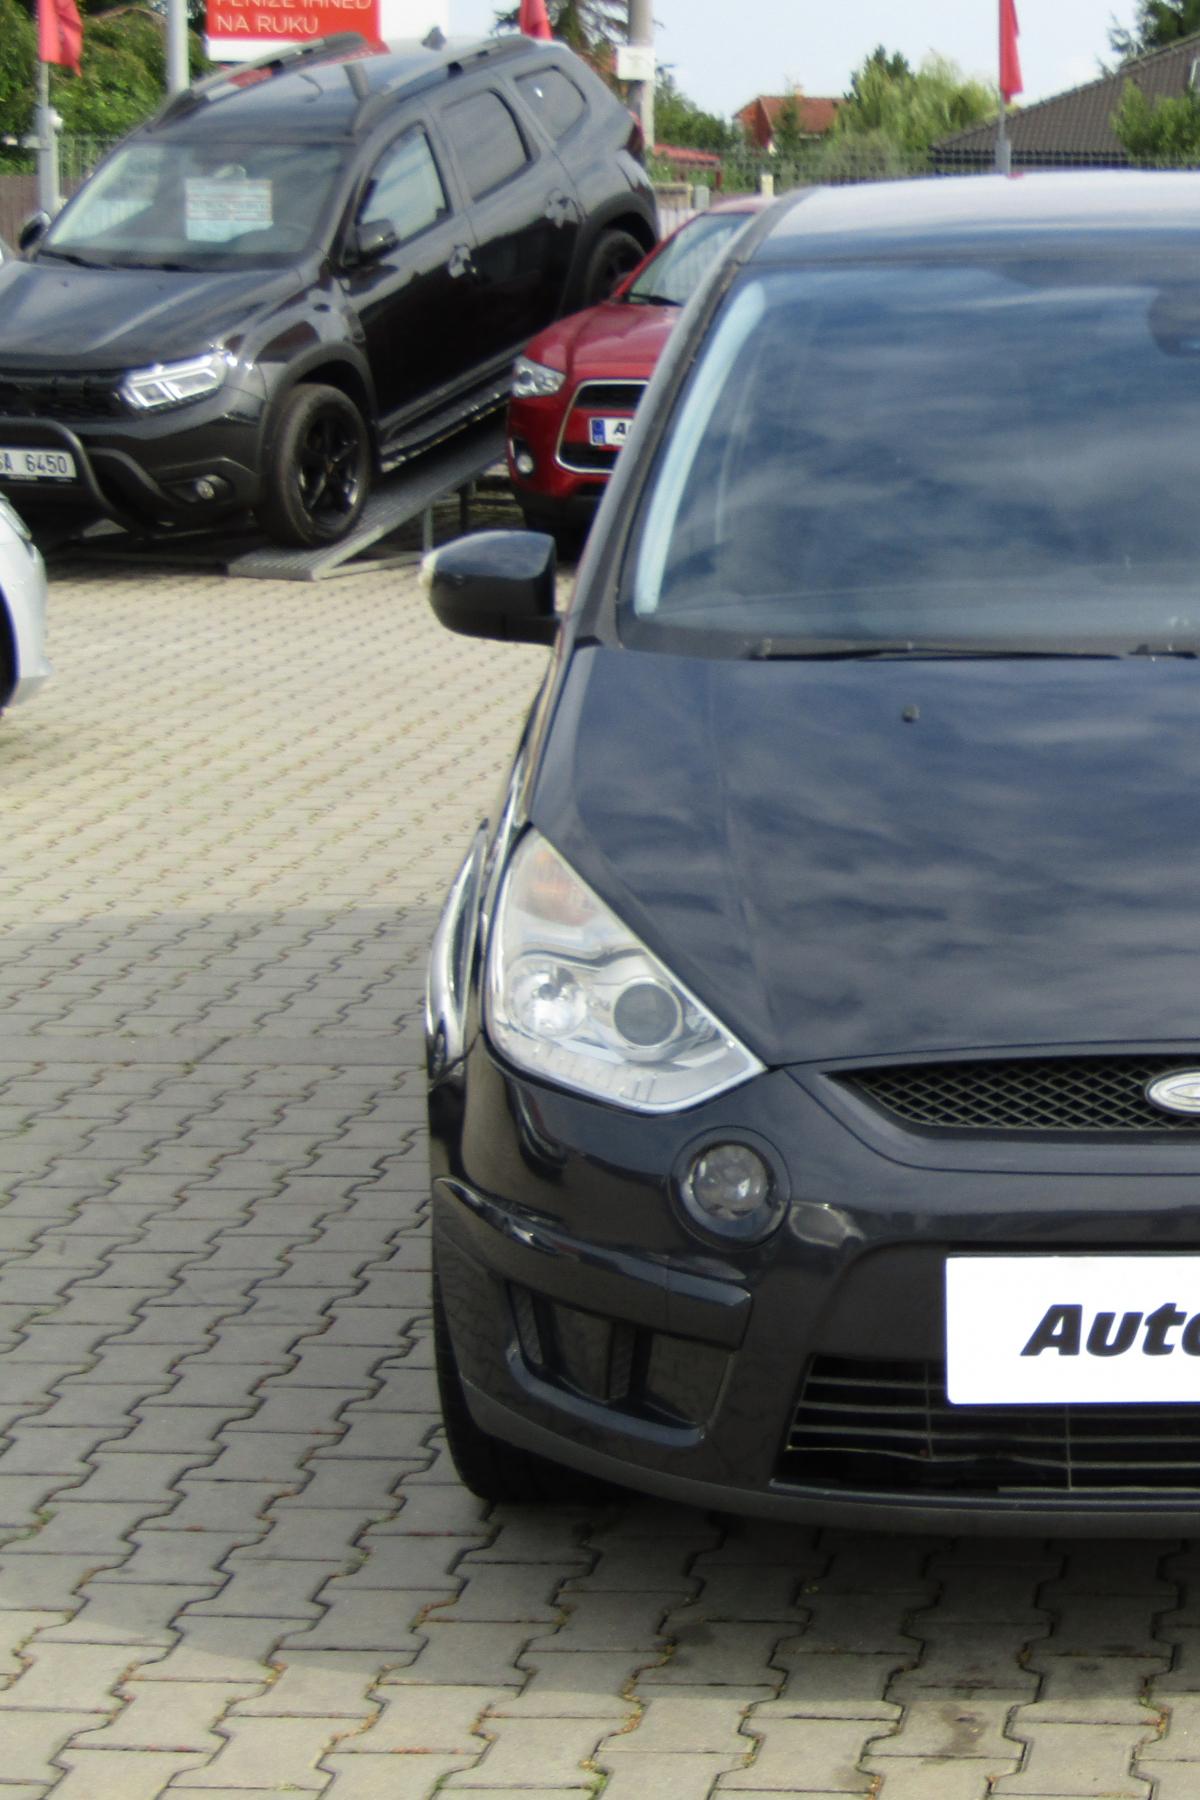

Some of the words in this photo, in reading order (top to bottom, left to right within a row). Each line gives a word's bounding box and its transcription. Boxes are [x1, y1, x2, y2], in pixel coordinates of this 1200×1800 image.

[217, 15, 250, 32] NA
[257, 16, 318, 33] RUKU
[25, 454, 67, 474] 6450
